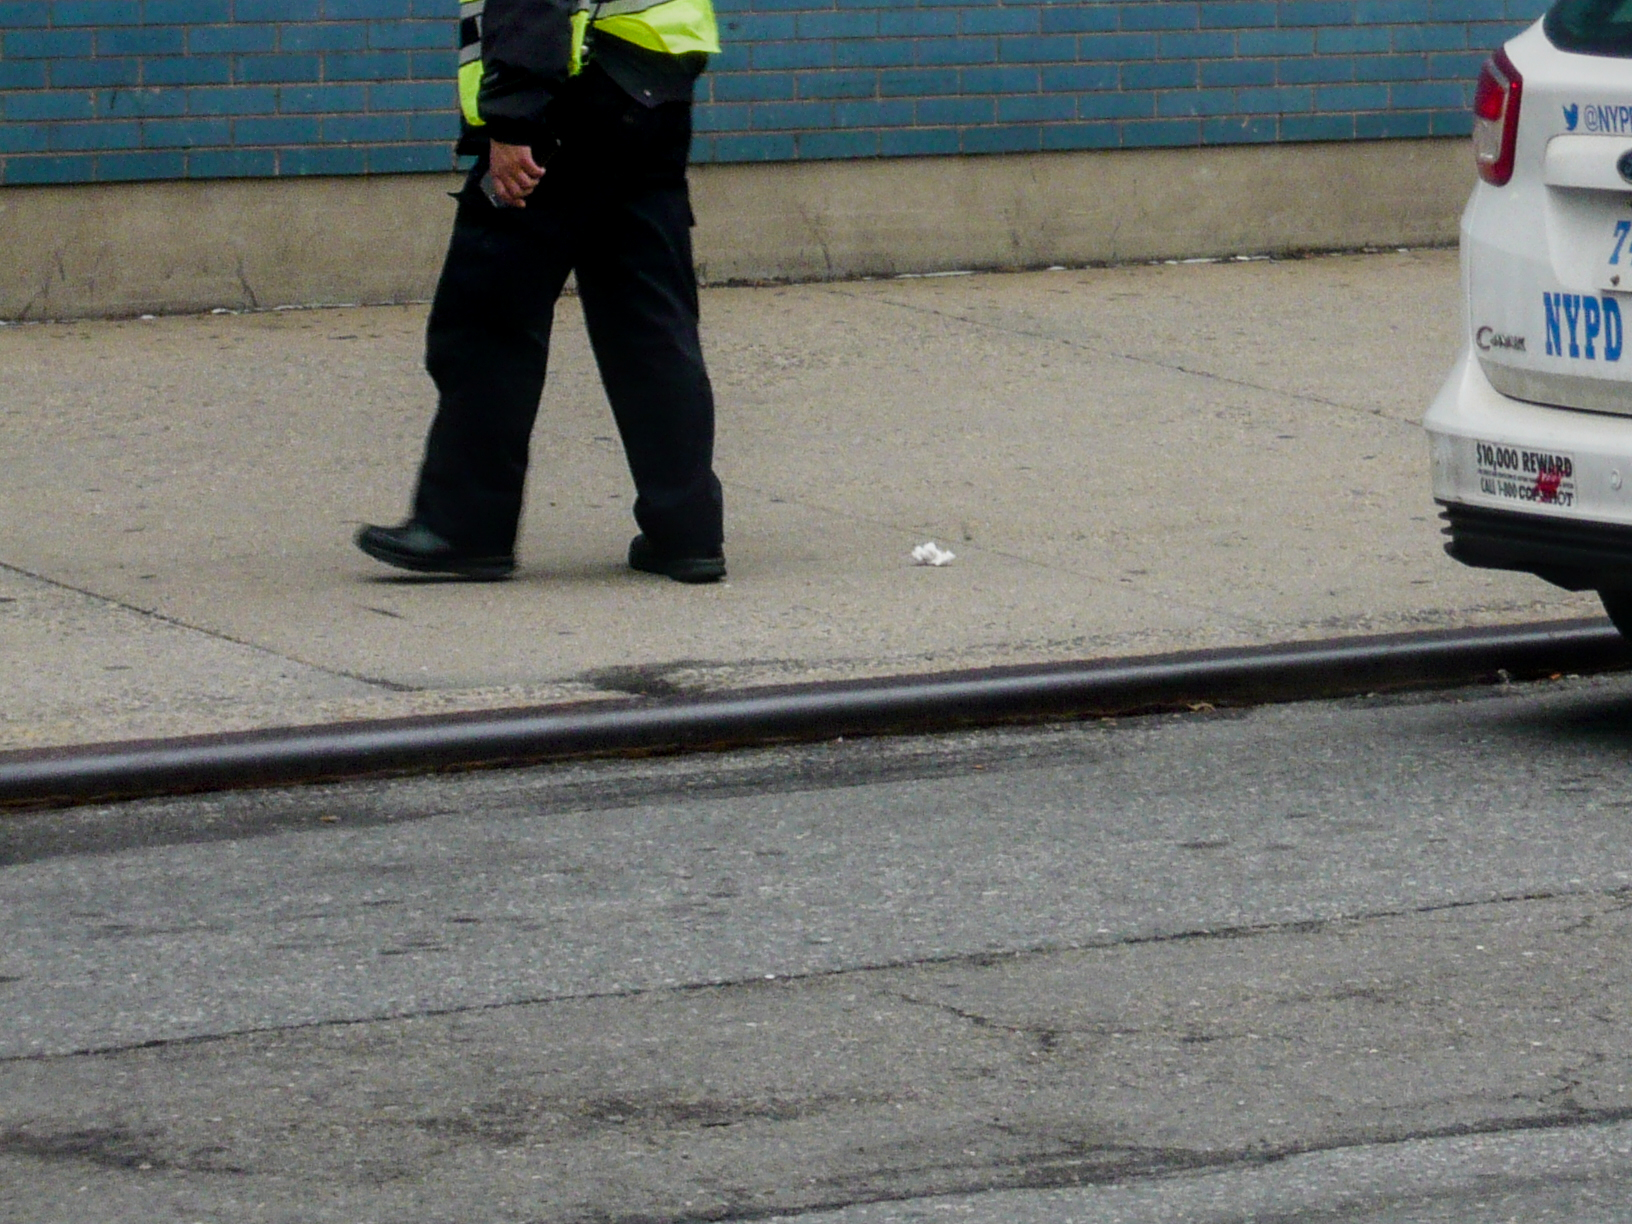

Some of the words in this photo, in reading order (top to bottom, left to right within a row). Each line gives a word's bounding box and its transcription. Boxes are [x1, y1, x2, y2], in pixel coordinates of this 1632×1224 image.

[1543, 292, 1623, 362] NYPD
[1476, 442, 1519, 472] $10,000
[1521, 451, 1573, 478] REWARD
[1480, 476, 1497, 495] CALL
